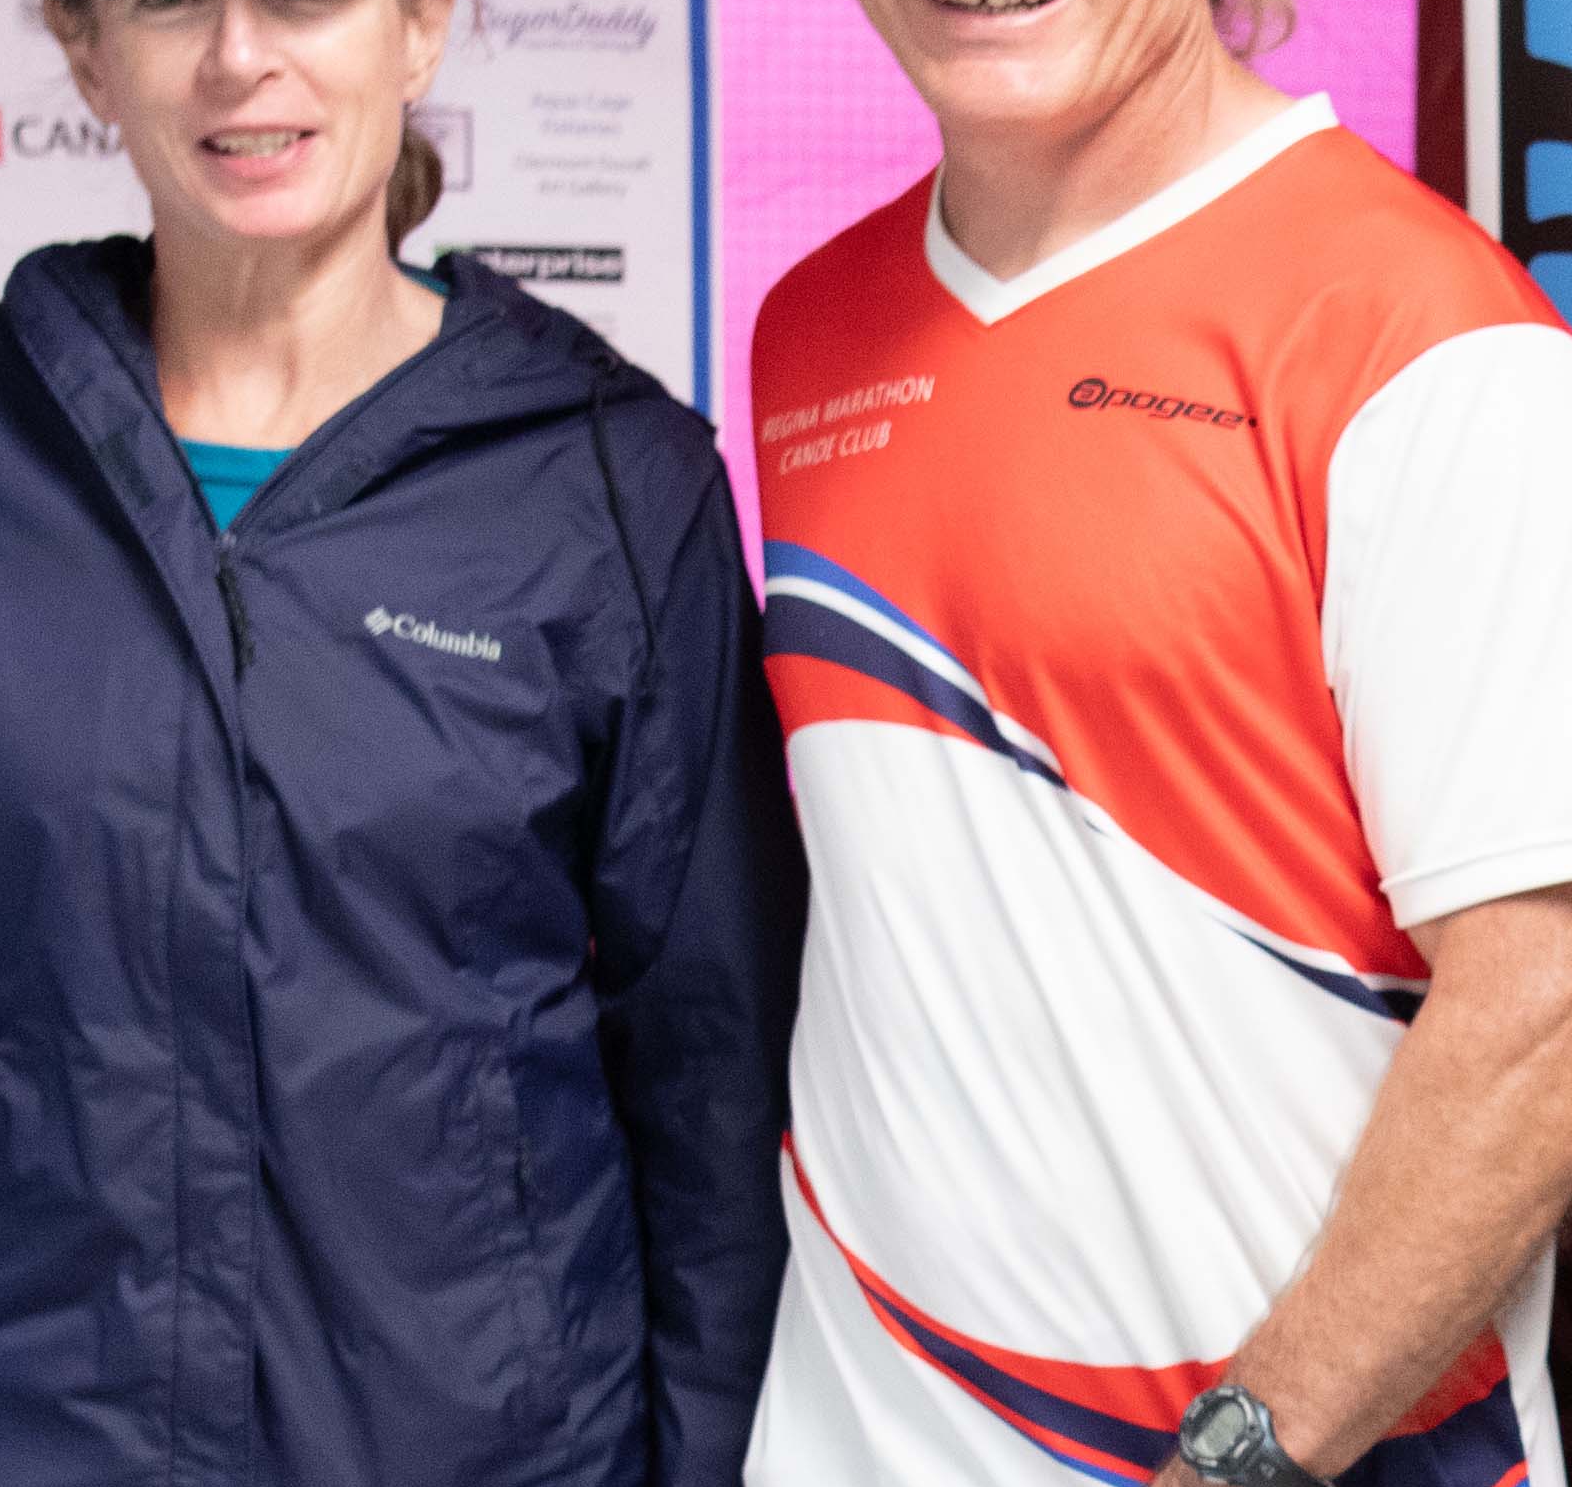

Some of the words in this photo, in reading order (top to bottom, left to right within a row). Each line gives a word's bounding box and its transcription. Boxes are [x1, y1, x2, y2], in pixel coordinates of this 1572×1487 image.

[823, 375, 936, 423] MARATHON
[779, 433, 837, 476] CANOE
[838, 418, 893, 458] CLUB
[392, 613, 503, 662] Columbia
